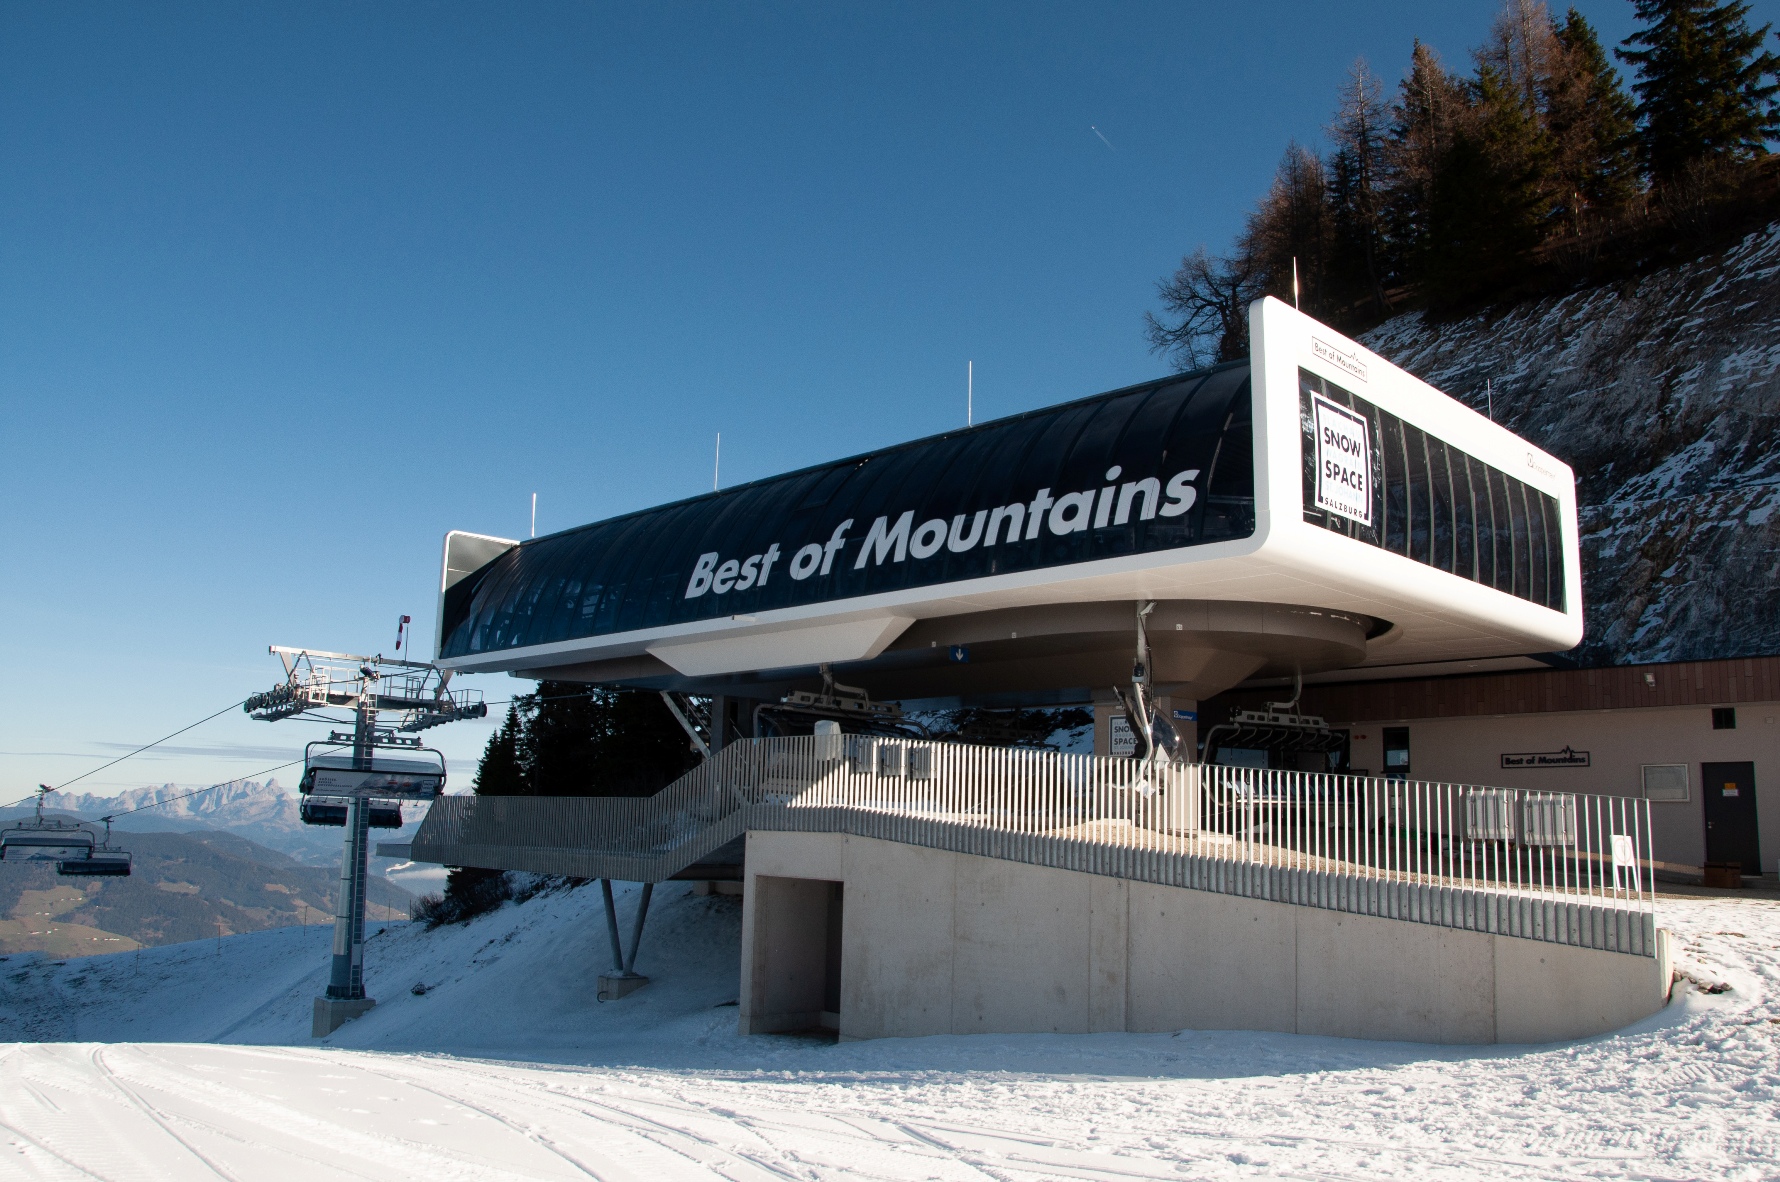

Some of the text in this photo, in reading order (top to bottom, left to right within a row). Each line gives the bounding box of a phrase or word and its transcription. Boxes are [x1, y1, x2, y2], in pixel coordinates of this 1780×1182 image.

[1324, 426, 1361, 458] SNOW
[1325, 459, 1363, 492] SPACE
[1324, 497, 1363, 518] SALZBURG
[684, 465, 1200, 600] Best of Mountains
[1114, 738, 1136, 746] SPACE
[1505, 754, 1586, 765] Best of Mountains
